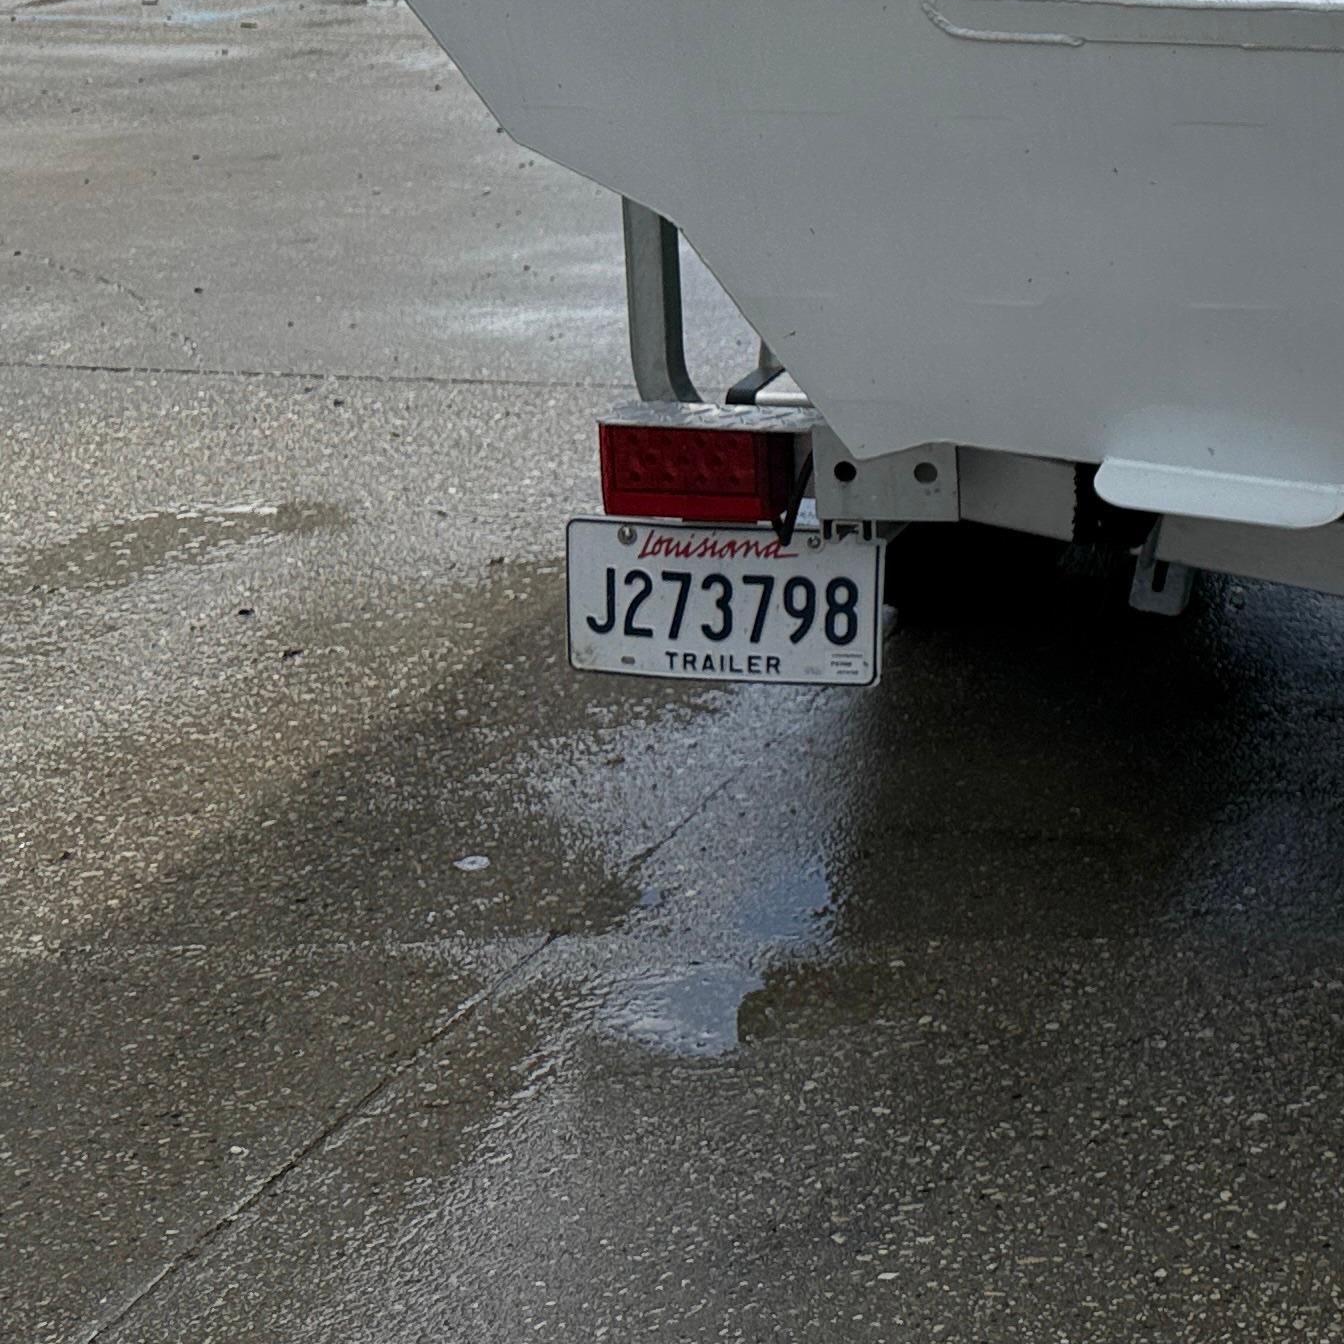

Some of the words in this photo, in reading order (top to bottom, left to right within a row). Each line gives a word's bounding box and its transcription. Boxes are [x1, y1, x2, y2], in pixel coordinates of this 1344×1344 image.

[638, 529, 799, 560] Louisiana
[586, 567, 860, 646] J273798
[665, 651, 781, 675] TRAILER
